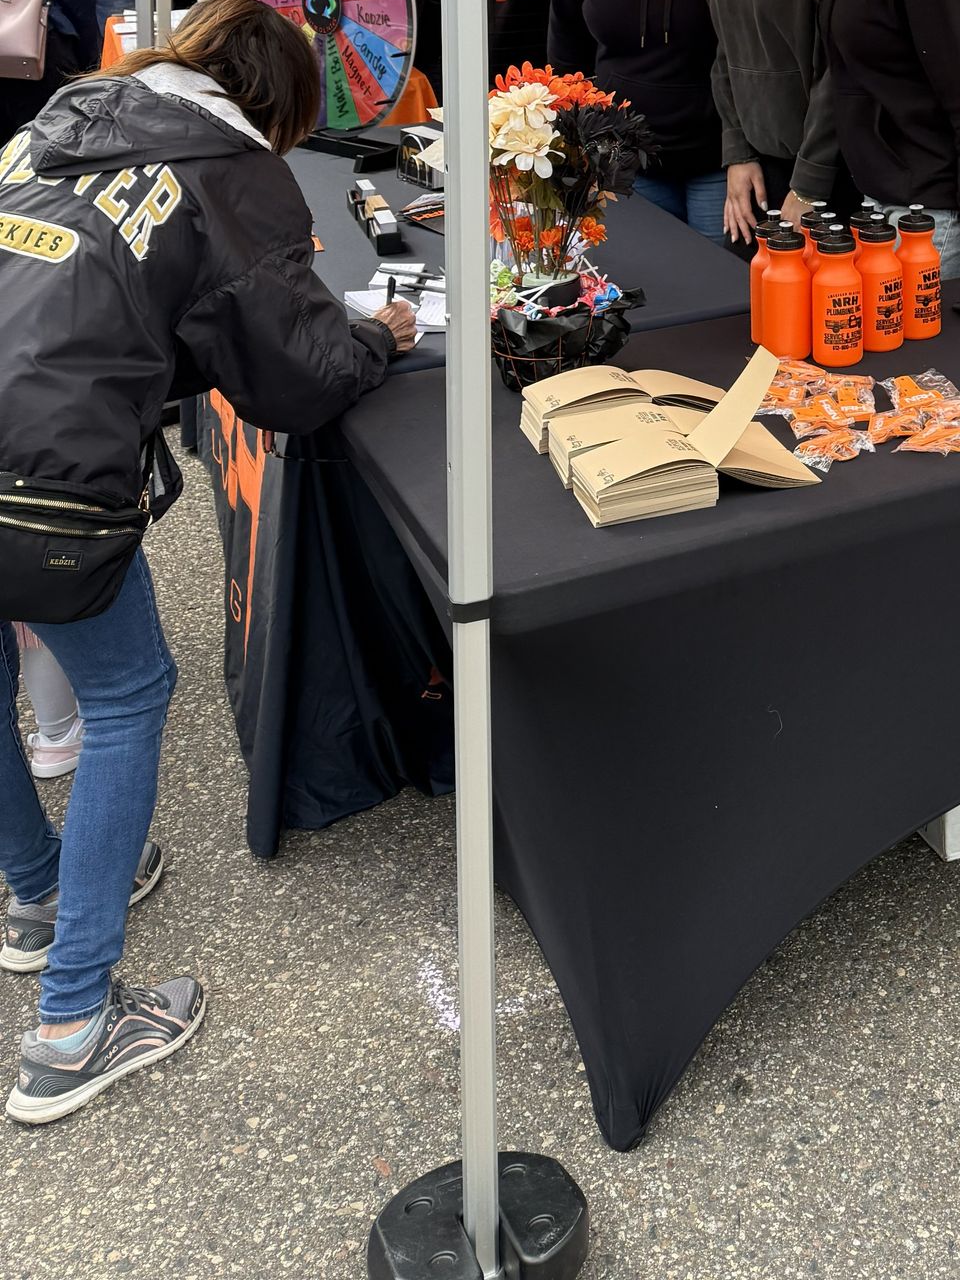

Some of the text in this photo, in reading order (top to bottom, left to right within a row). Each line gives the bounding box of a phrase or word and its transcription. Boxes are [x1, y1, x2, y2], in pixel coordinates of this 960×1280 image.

[341, 44, 374, 99] Magnet
[352, 31, 387, 81] Candy
[832, 295, 859, 308] NRH
[49, 558, 77, 566] KEDZIE
